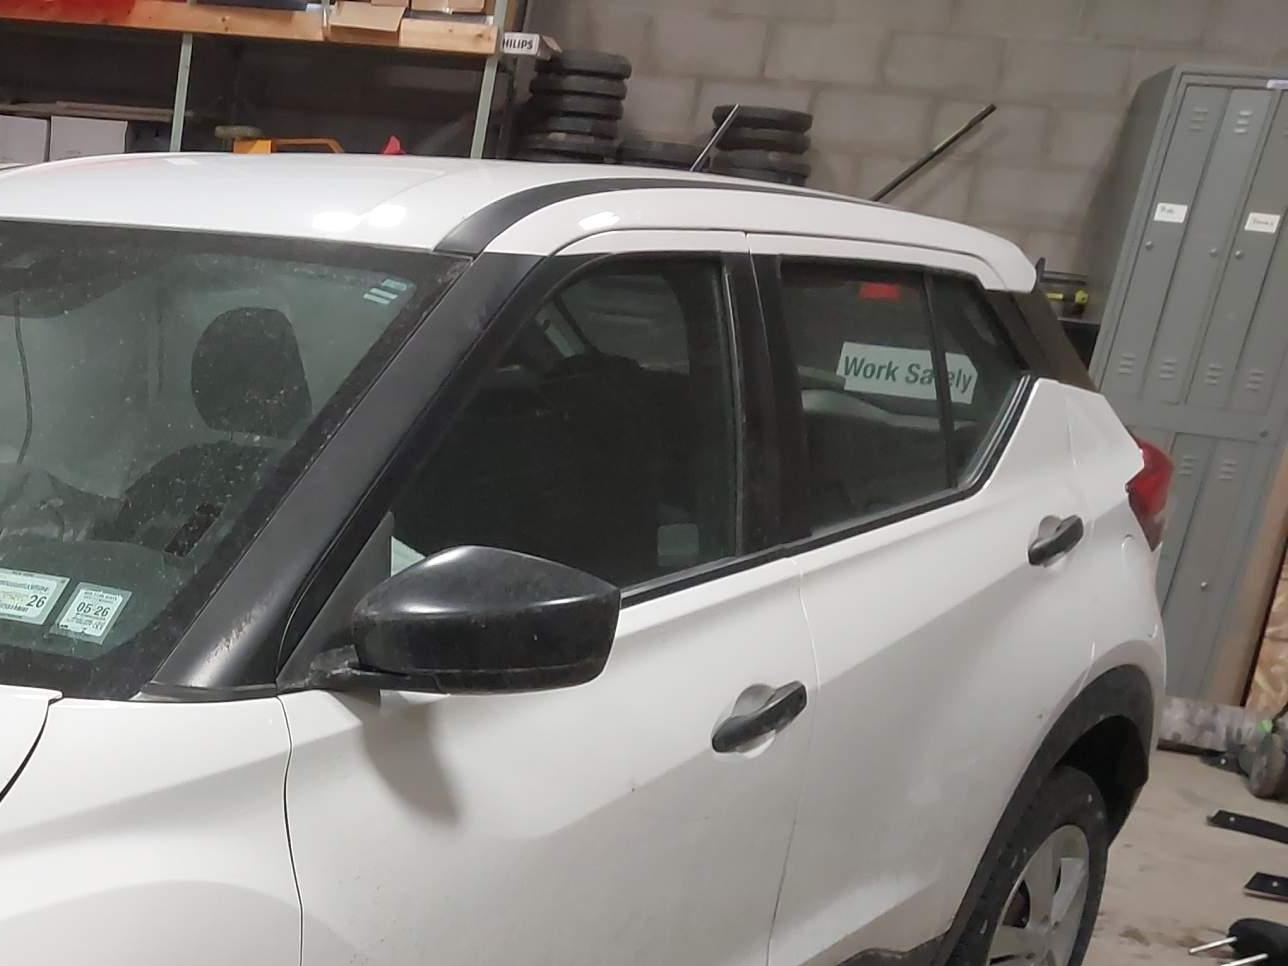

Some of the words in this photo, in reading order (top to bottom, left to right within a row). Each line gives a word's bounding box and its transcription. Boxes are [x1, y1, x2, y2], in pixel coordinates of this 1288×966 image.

[502, 39, 533, 50] HILIPS
[844, 355, 899, 382] Work
[905, 363, 973, 395] Saely
[26, 594, 47, 608] 26
